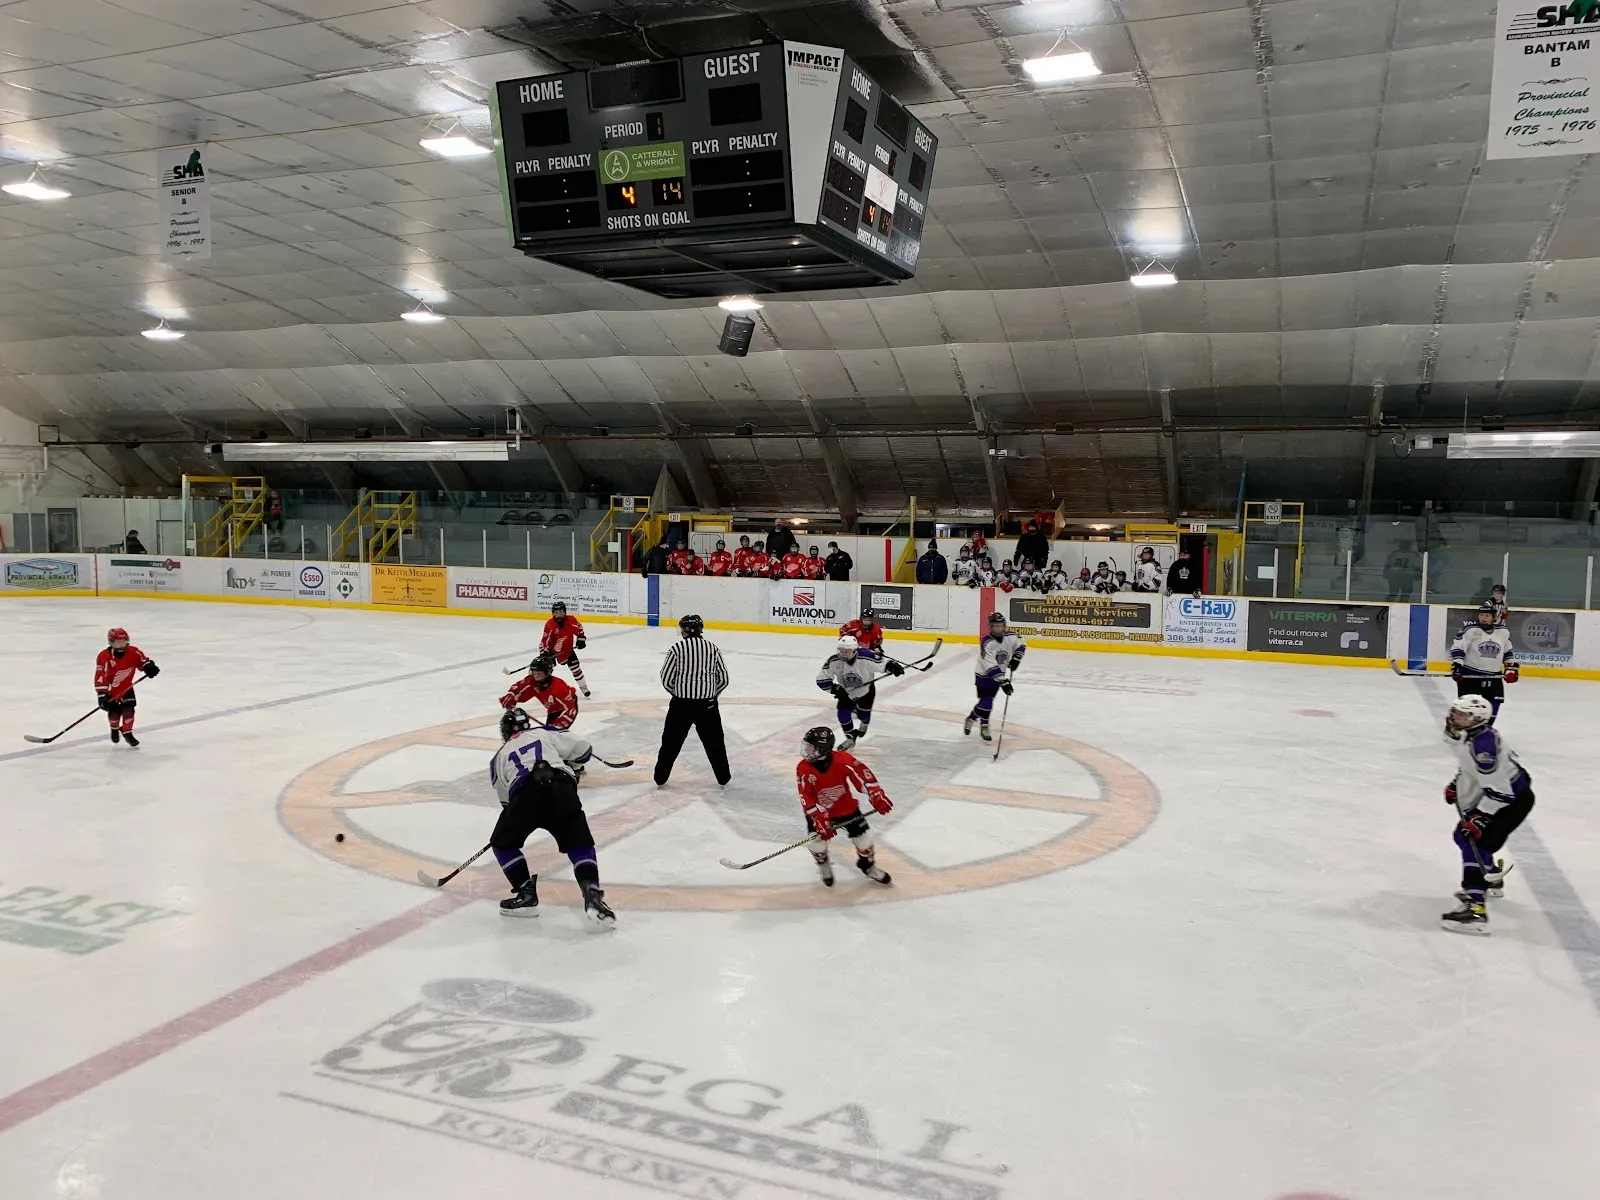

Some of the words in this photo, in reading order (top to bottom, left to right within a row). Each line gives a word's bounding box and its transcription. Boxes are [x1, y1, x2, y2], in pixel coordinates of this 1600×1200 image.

[1524, 39, 1590, 55] BANTAM
[704, 52, 760, 79] GUEST
[787, 49, 841, 68] IMPACT
[1550, 57, 1561, 68] B
[851, 68, 872, 100] HOME
[519, 80, 564, 104] HOME
[1517, 87, 1590, 103] Provincial
[1514, 106, 1590, 121] Champions
[604, 121, 643, 139] PERIOD
[1505, 124, 1541, 136] 1975
[1561, 120, 1598, 132] 1976
[691, 139, 720, 155] PLYR
[728, 132, 778, 151] PENALTY
[914, 126, 933, 154] GUEST
[631, 149, 678, 160] CATTERALL
[832, 140, 846, 160] PLYR
[847, 150, 867, 174] PENALTY
[515, 160, 540, 174] PLYR
[548, 154, 592, 171] PENALTY
[643, 157, 675, 167] WRIGHT
[171, 187, 196, 197] SENIOR
[621, 186, 635, 205] 4
[662, 181, 682, 201] 14
[607, 214, 641, 230] SHOTS
[644, 212, 660, 227] ON
[662, 210, 691, 226] GOAL
[1192, 524, 1204, 533] EXIT
[270, 570, 292, 578] PIONEER
[408, 568, 444, 578] MESZAROS
[458, 585, 525, 599] PHARMASAVE
[578, 594, 594, 603] Hockey
[601, 595, 618, 604] Biggar
[1045, 595, 1113, 608] BOISVERT
[1183, 599, 1232, 618] E-Kay
[772, 606, 836, 619] HAMMOND
[1023, 604, 1088, 616] Underground
[1093, 607, 1138, 618] Services
[1269, 610, 1338, 622] VITERRA
[782, 617, 826, 625] REALTY
[1165, 624, 1189, 633] Builders
[1190, 627, 1198, 635] of
[1198, 626, 1213, 634] Back
[1215, 627, 1240, 635] Savers!
[1186, 635, 1204, 643] 948
[1213, 636, 1236, 644] 2544
[1268, 637, 1304, 646] viterra.ca
[1514, 653, 1571, 662] 06-948-9307
[508, 739, 543, 777] 17
